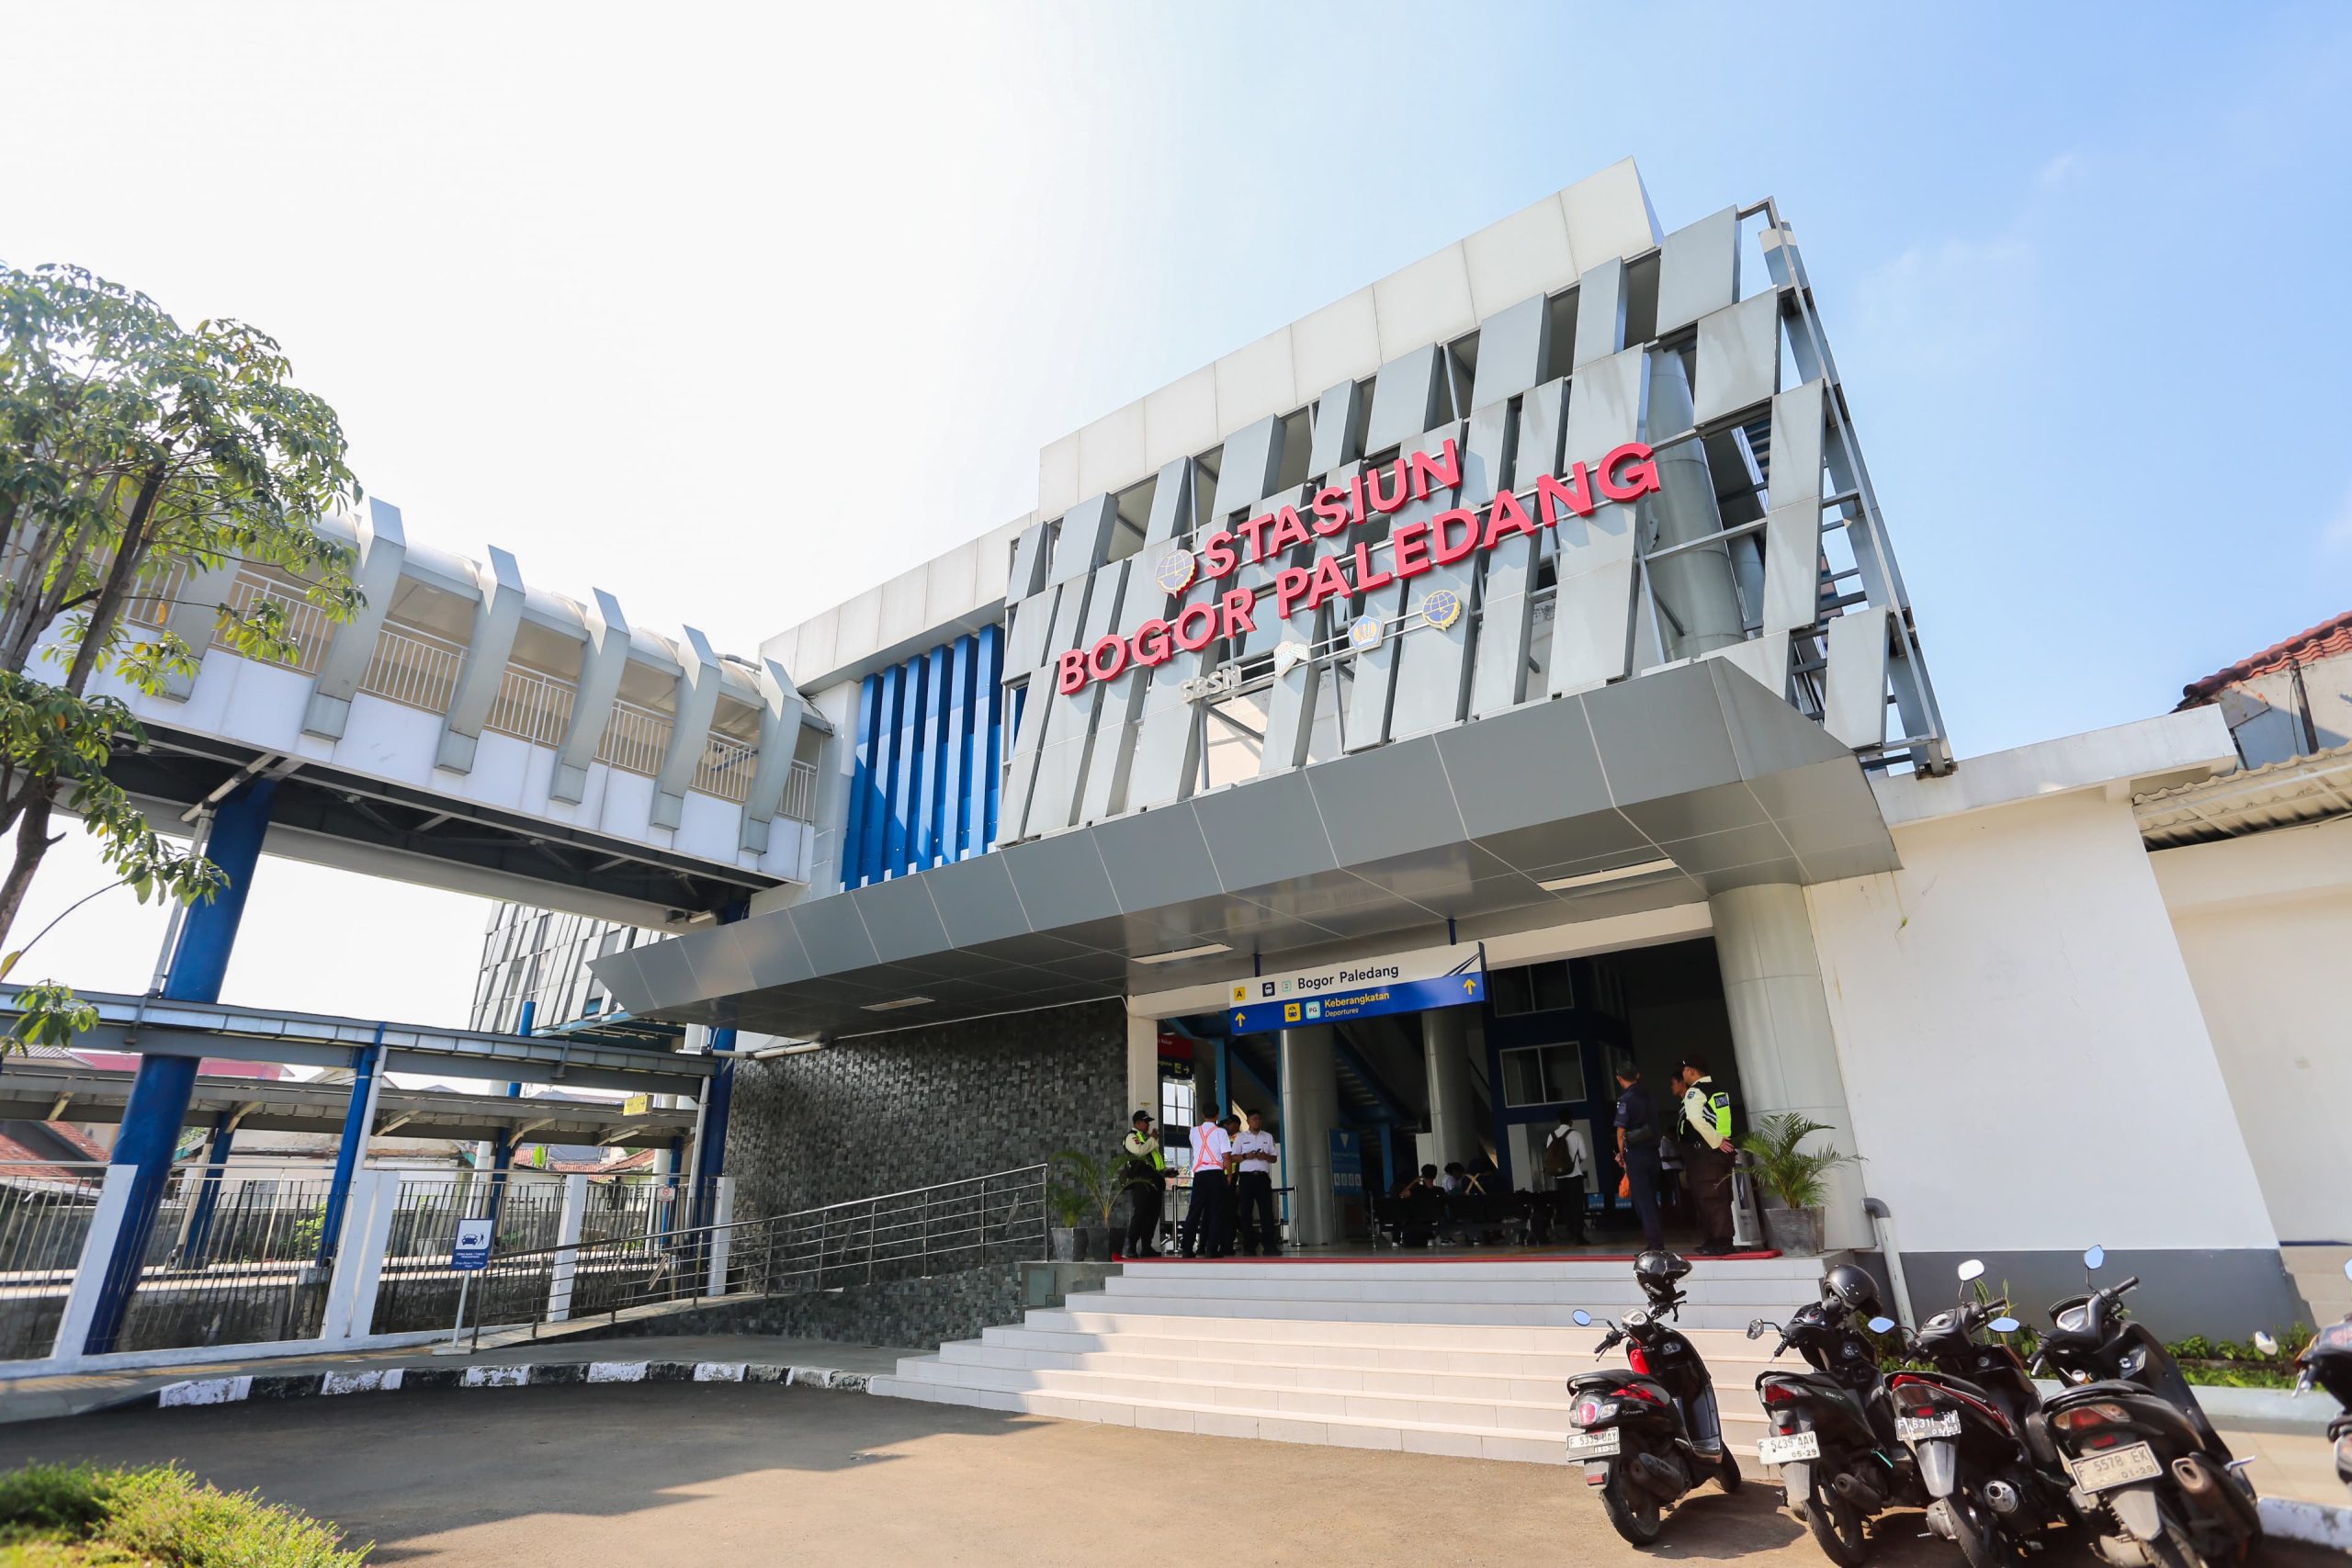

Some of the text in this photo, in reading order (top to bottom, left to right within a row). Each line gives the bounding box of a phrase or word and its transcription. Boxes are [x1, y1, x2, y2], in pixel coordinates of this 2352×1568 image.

[1204, 437, 1463, 581] STASIUN
[1059, 442, 1662, 695] BOGOR PALEDANG
[1180, 664, 1242, 703] SBSN
[1297, 976, 1334, 990] Bogor
[1340, 965, 1399, 984] Paledang
[1236, 989, 1243, 998] A
[1324, 991, 1390, 1009] Keberangkatan
[1308, 1006, 1317, 1014] PG
[1325, 1007, 1359, 1018] Departures
[1897, 1419, 1905, 1429] F
[1758, 1441, 1765, 1452] F
[1770, 1438, 1793, 1450] 5439
[2076, 1450, 2149, 1478] F 5578 EK
